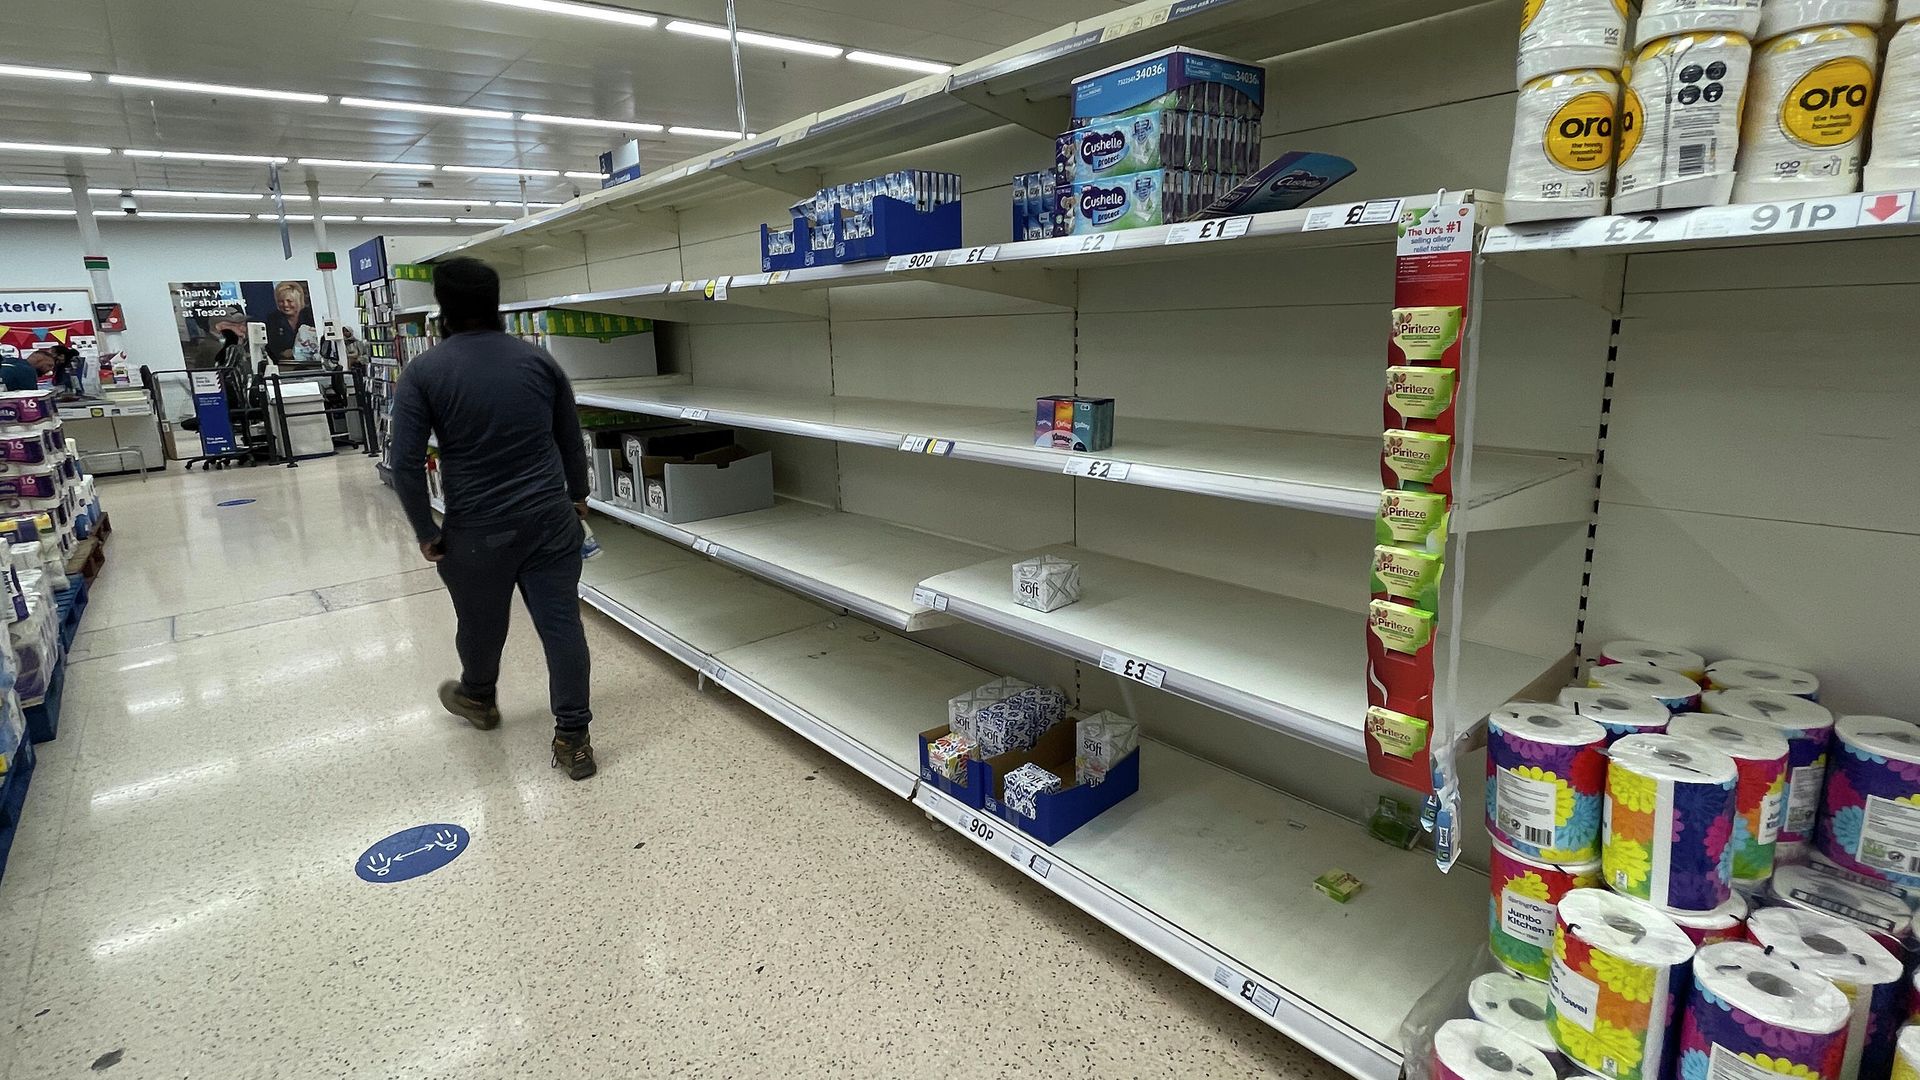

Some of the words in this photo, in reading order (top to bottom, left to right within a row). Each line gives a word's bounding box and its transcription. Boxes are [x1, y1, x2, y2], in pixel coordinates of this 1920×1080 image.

[1799, 84, 1867, 111] ora
[1560, 117, 1612, 138] ora
[1083, 137, 1123, 156] Cushelle
[1097, 154, 1120, 168] protect
[1082, 192, 1123, 210] Cushelle
[1097, 210, 1120, 223] protect
[1750, 203, 1837, 232] 91p
[1199, 219, 1225, 239] £1
[1408, 229, 1423, 237] The
[1425, 226, 1444, 235] UK's
[1446, 220, 1462, 233] #1
[1604, 216, 1660, 243] £2
[1079, 236, 1105, 252] £2
[1411, 237, 1431, 245] selling
[1433, 235, 1455, 243] allergy
[966, 248, 985, 263] £1
[1413, 245, 1430, 253] relief
[908, 253, 933, 269] 90p
[177, 288, 211, 298] Thank
[213, 289, 232, 298] you
[180, 299, 196, 307] for
[199, 298, 247, 308] shopping
[182, 310, 194, 318] at
[195, 308, 227, 317] Tesco
[1401, 323, 1441, 334] Piriteze
[1395, 383, 1435, 395] Piriteze
[21, 399, 37, 408] 16
[8, 441, 24, 450] 16
[1392, 447, 1431, 460] Piriteze
[1087, 461, 1111, 478] £2
[21, 476, 36, 485] 16
[1389, 505, 1427, 519] Piriteze
[1383, 562, 1420, 577] Piriteze
[1020, 582, 1040, 599] soft
[1378, 617, 1414, 634] Piriteze
[1124, 659, 1145, 680] £3
[955, 715, 970, 730] soft
[983, 727, 998, 744] soft
[1375, 724, 1411, 741] Piriteze
[1083, 740, 1102, 756] soft
[969, 818, 994, 841] 90p
[1508, 907, 1542, 925] Jumbo
[1508, 915, 1545, 934] Kitchen
[1240, 980, 1256, 1000] £
[1561, 991, 1588, 1015] Towel
